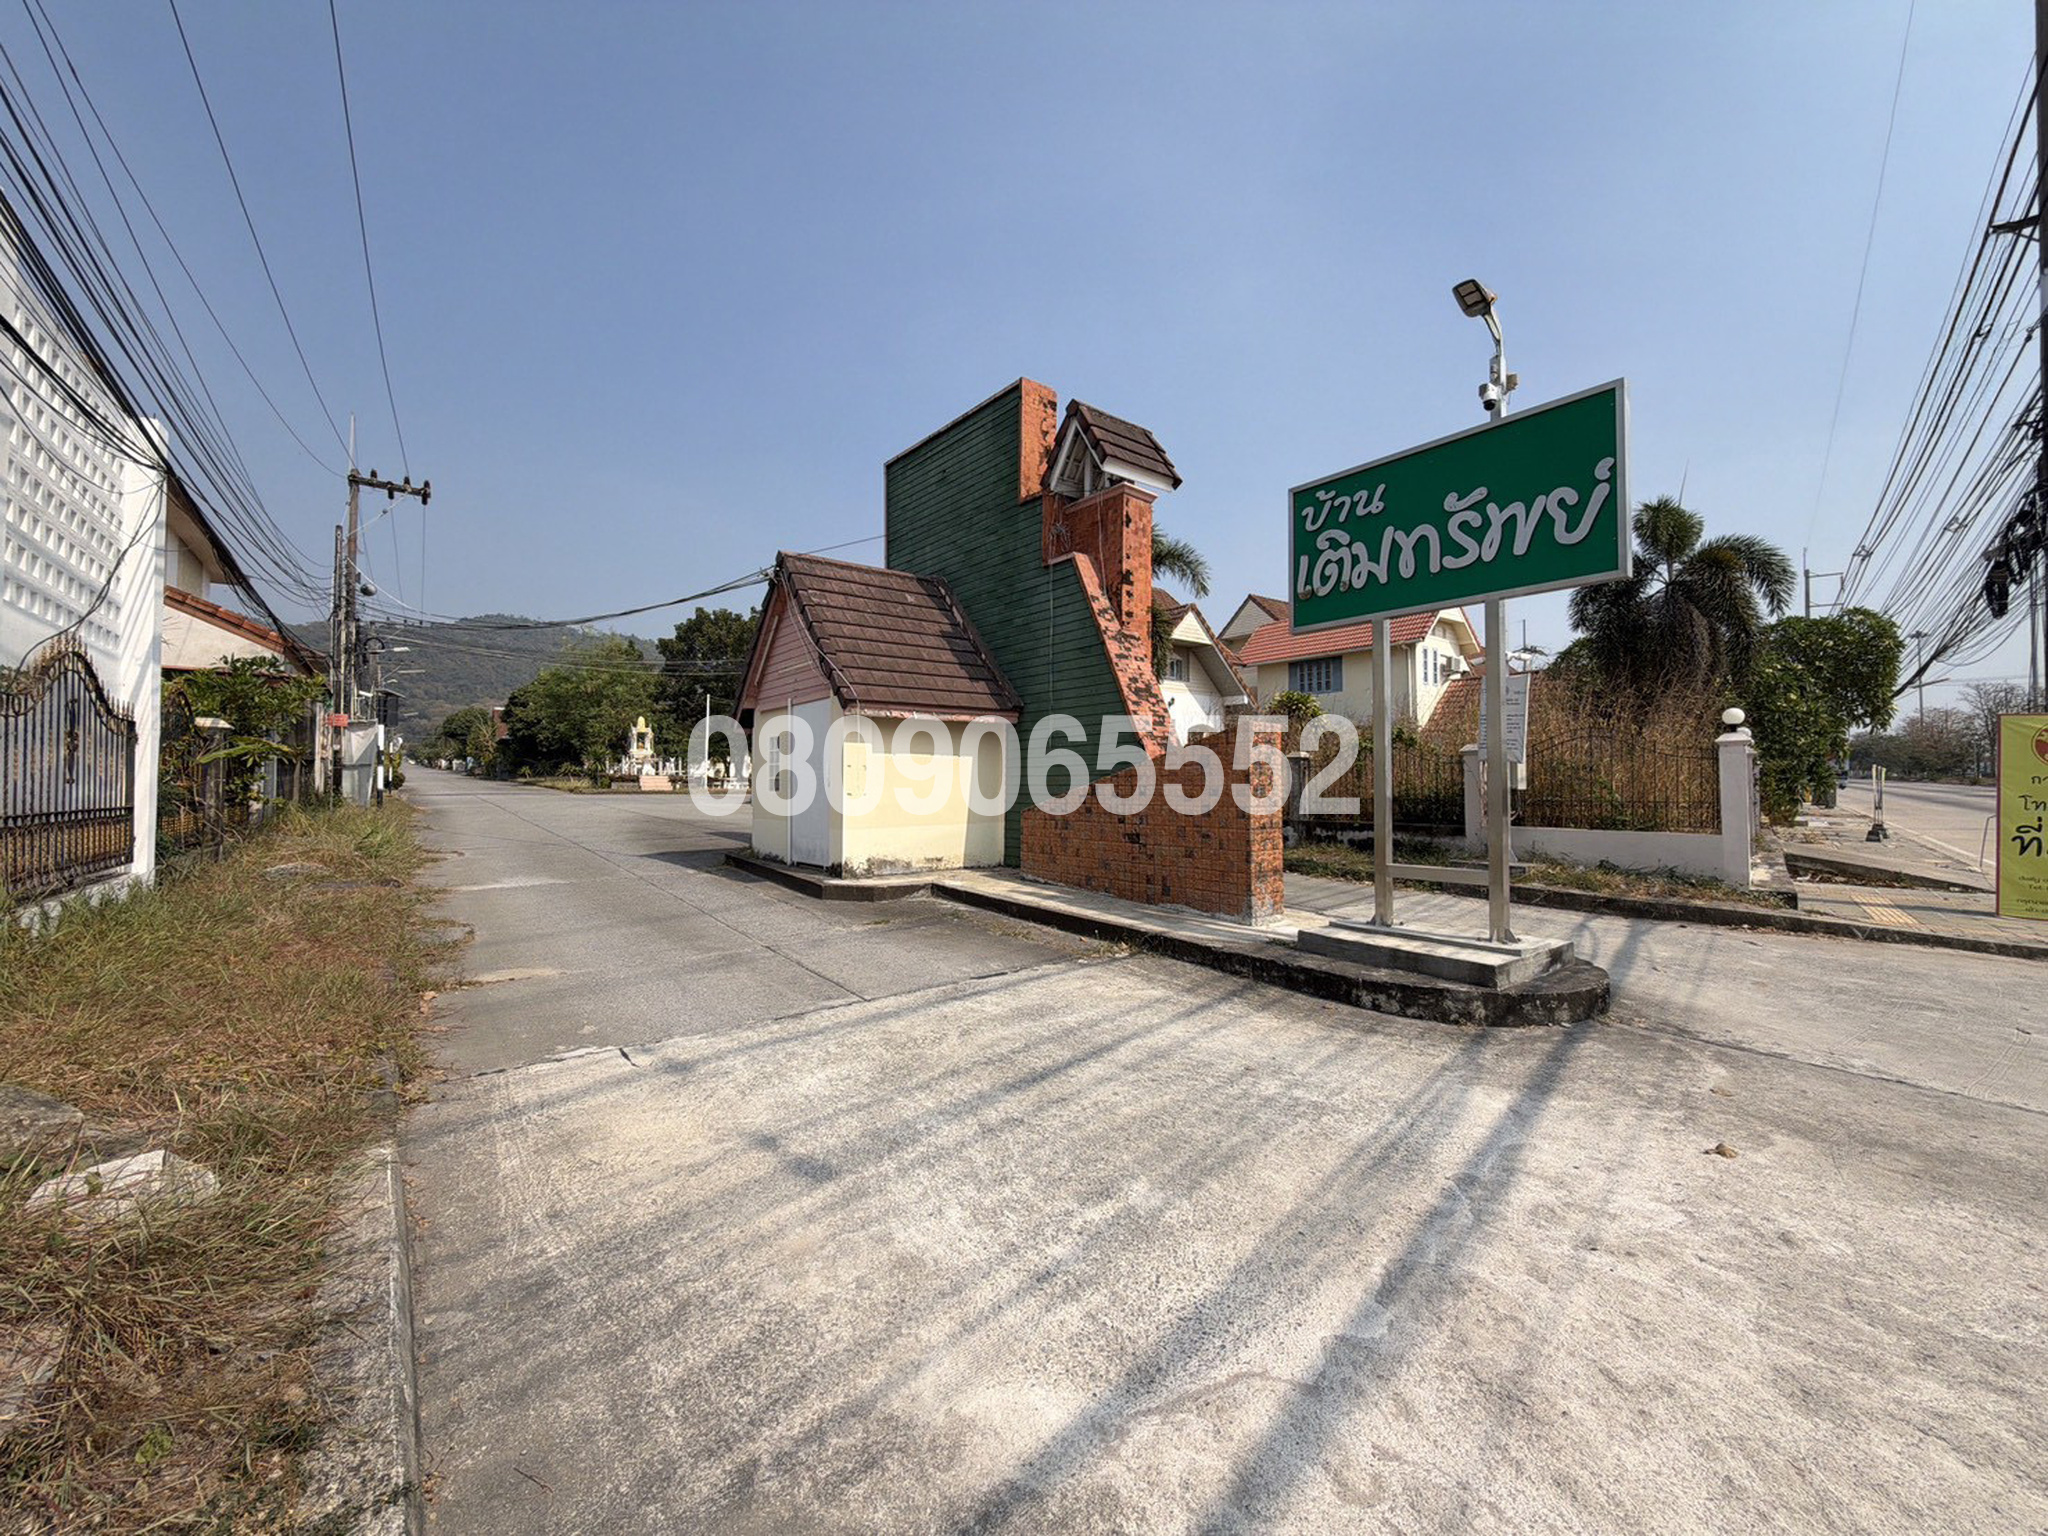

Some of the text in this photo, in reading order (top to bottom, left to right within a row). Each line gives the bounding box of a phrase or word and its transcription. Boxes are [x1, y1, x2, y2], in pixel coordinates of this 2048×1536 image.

[1297, 456, 1615, 600] เติมทรัพย์
[1301, 484, 1386, 532] บ้าน
